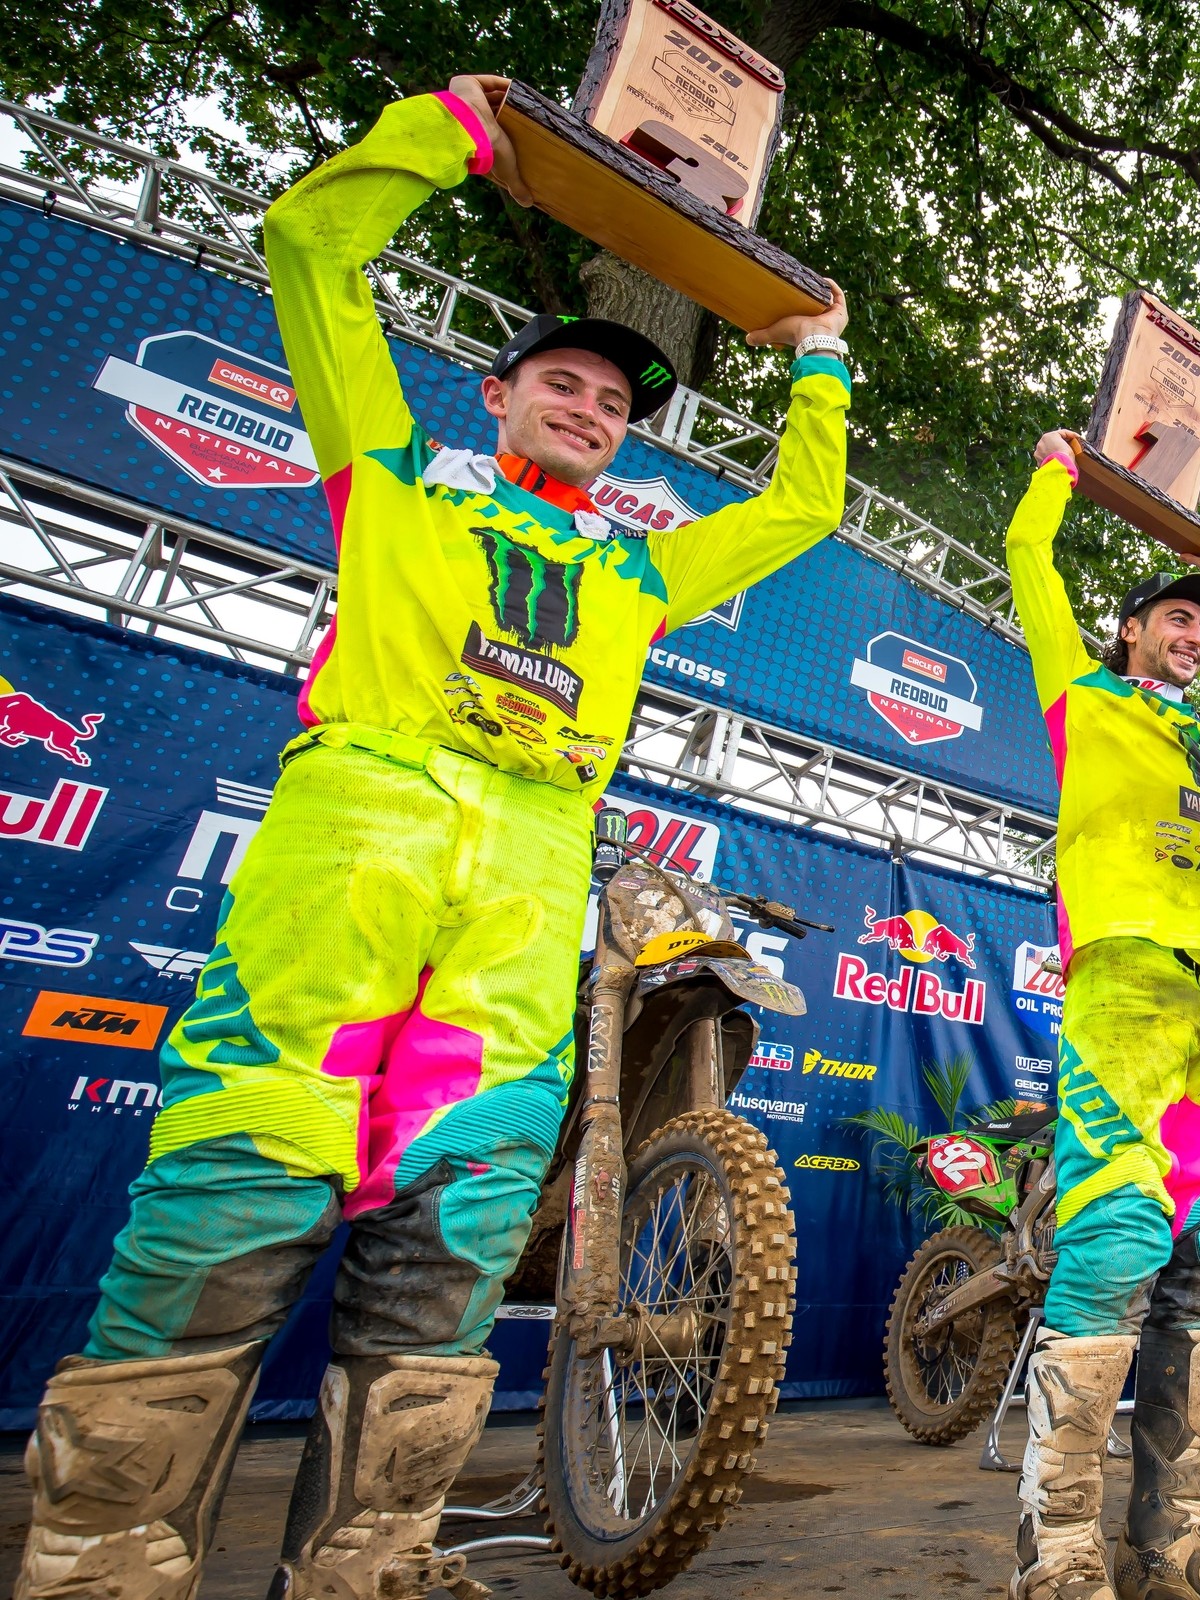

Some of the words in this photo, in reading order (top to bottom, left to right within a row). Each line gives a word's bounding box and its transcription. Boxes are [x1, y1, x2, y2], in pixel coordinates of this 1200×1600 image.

[656, 0, 786, 87] EDBUD
[664, 29, 744, 89] 2019
[680, 64, 707, 86] CIRCLE
[675, 75, 716, 109] REDBUD
[219, 368, 269, 394] CIRCLE
[270, 387, 290, 403] K
[176, 393, 295, 453] REDBUD
[154, 415, 297, 477] NATIONAL
[581, 478, 675, 530] LUCAS
[477, 630, 579, 704] YAMALUBE
[646, 646, 728, 688] cross
[906, 655, 932, 671] CIRCLE
[514, 696, 541, 710] TOYOTA
[890, 678, 949, 713] REDBUD
[880, 698, 952, 730] NATIONAL
[0, 918, 99, 967] PS
[834, 953, 913, 1011] Red
[913, 971, 985, 1024] Bull
[1024, 970, 1067, 996] LUC
[50, 1006, 142, 1038] KTM
[1016, 996, 1039, 1013] OIL
[1042, 1003, 1063, 1018] PRO
[818, 1059, 878, 1081] THOR
[1016, 1056, 1052, 1073] WPS
[1014, 1079, 1049, 1092] GEICO
[67, 1103, 159, 1118] WHEE
[731, 1092, 806, 1114] Husqvarna
[766, 1113, 804, 1123] MOTORCYCLES
[988, 1122, 1012, 1130] Kawasaki
[572, 1154, 589, 1210] YAMALUBE
